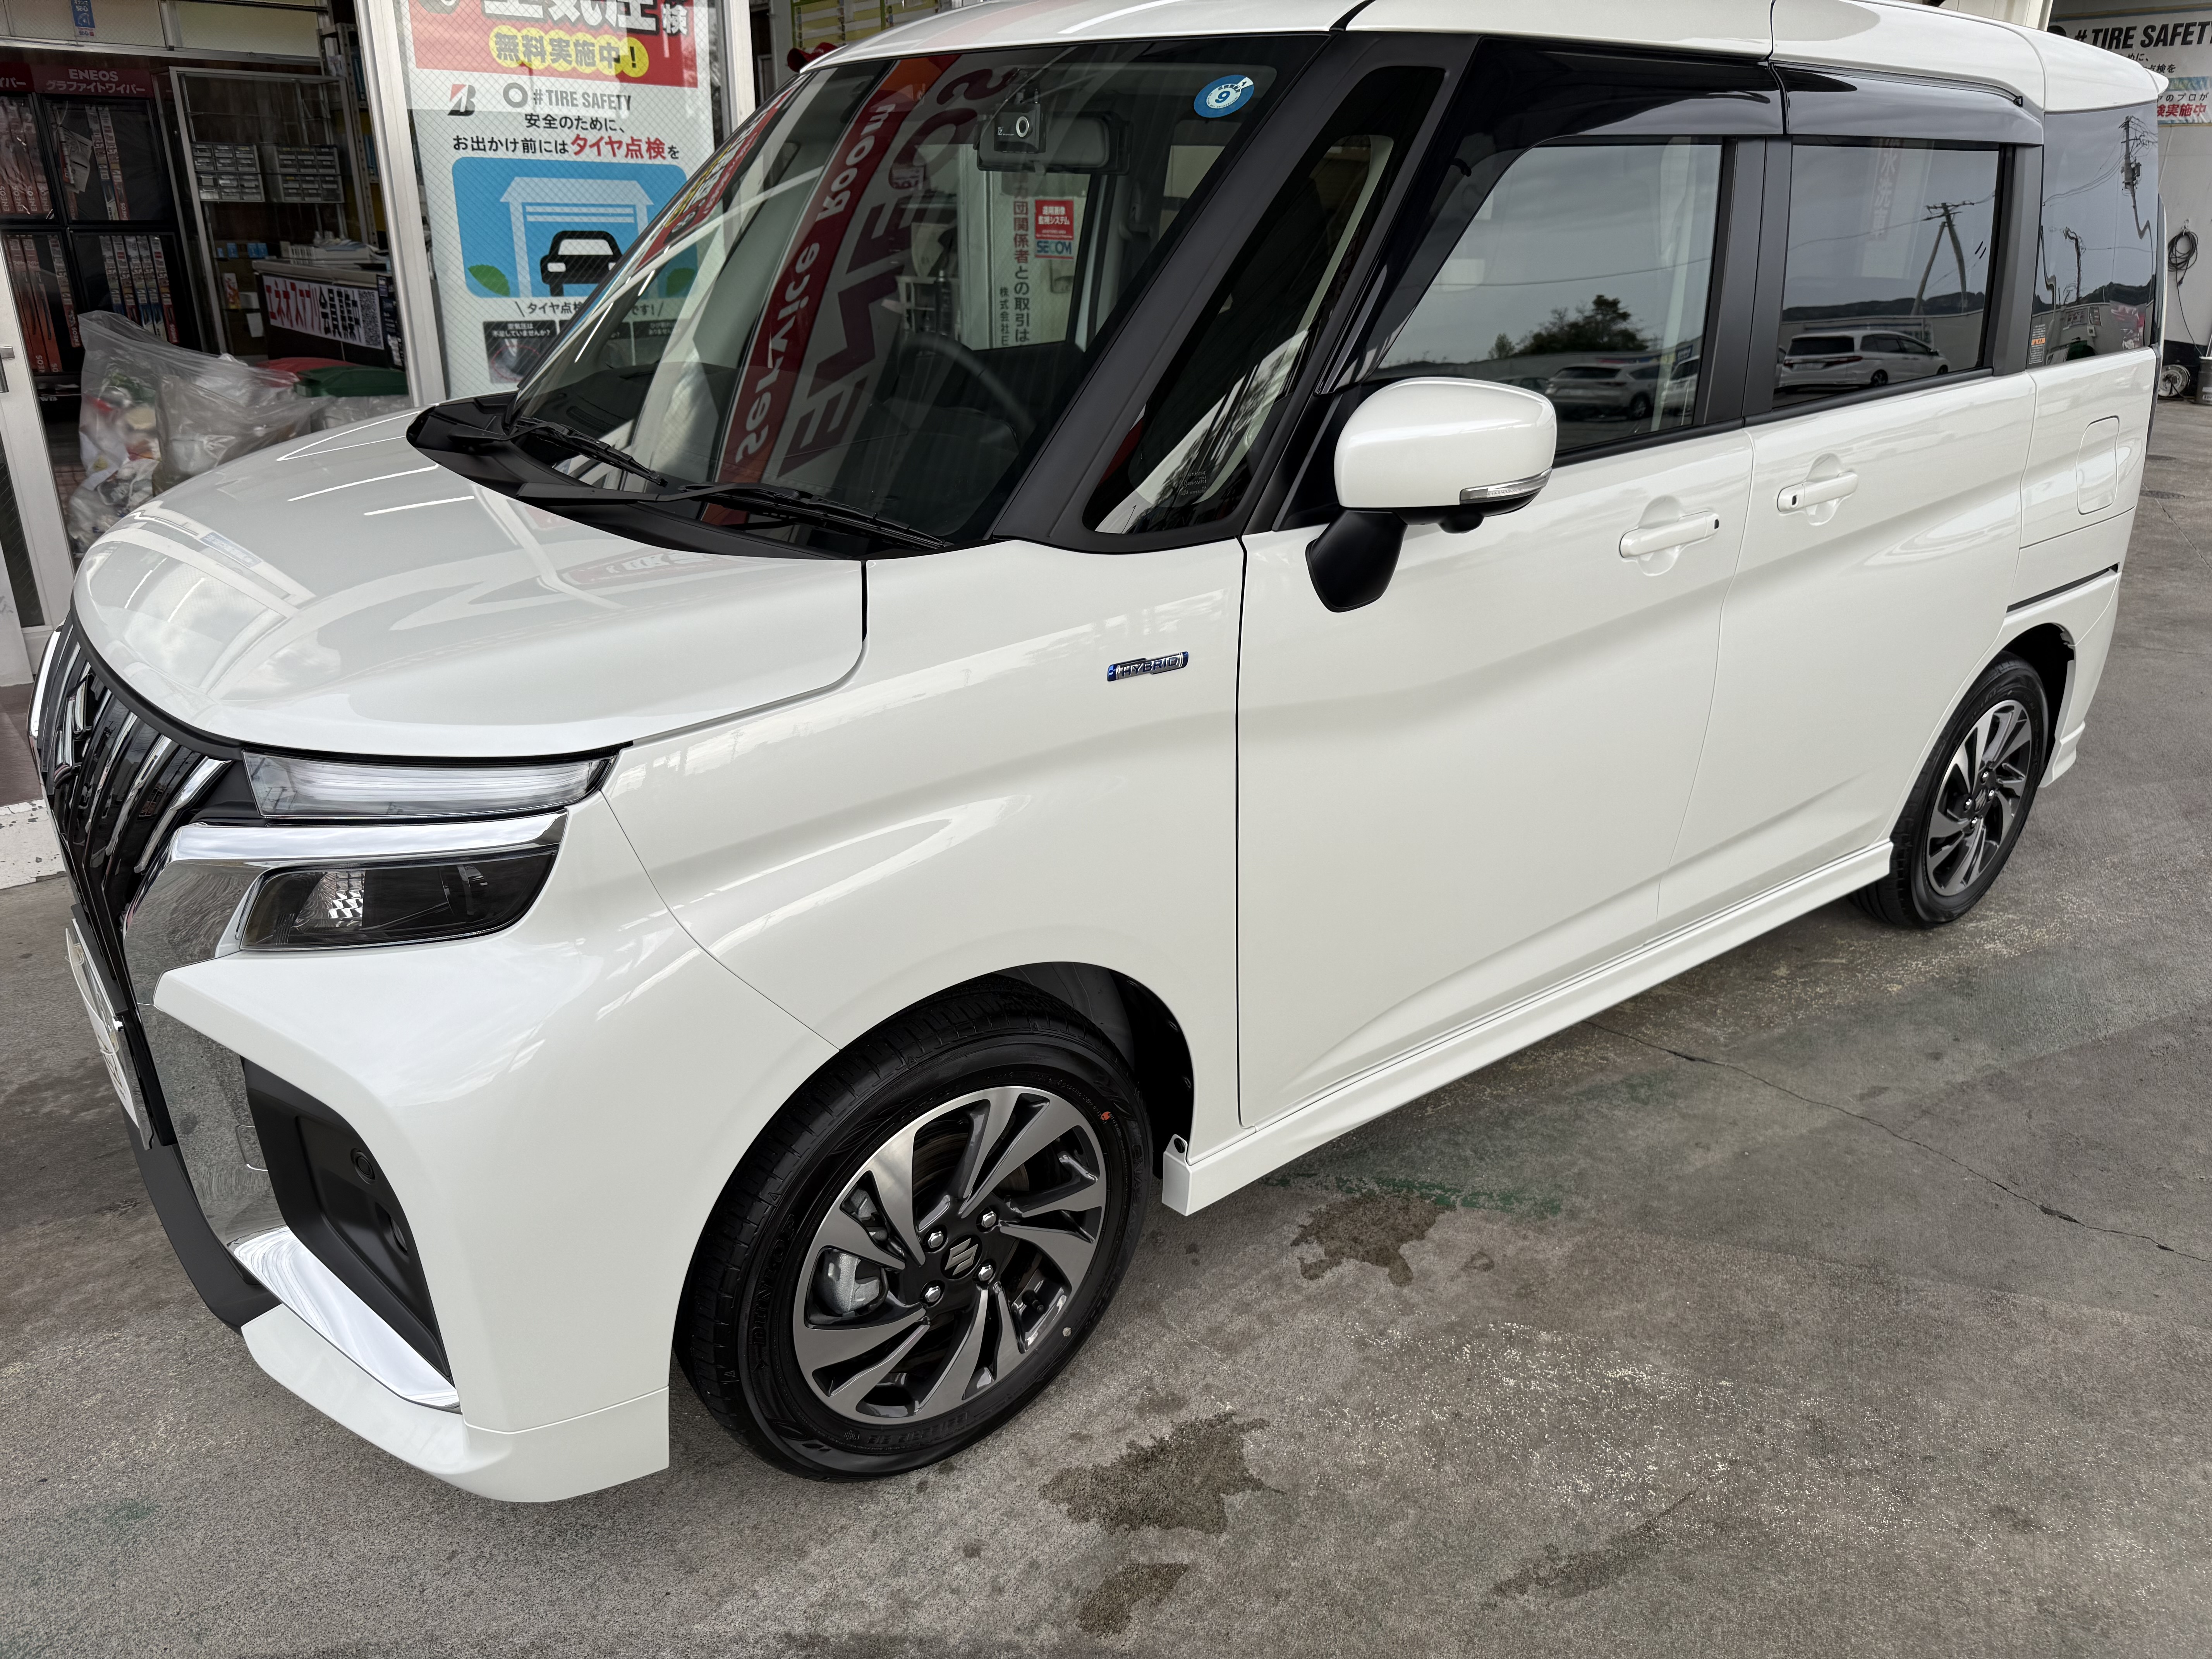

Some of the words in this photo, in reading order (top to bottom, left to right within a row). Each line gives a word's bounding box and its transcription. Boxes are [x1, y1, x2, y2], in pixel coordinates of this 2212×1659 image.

[2140, 21, 2212, 48] SAFET
[68, 69, 118, 82] ENEOS
[45, 80, 146, 94] グラファイトワイパー
[582, 92, 632, 111] SAFETY
[524, 113, 625, 133] 安全のために、
[453, 134, 680, 160] お出かけ前にはタイヤ点検を
[120, 202, 129, 220] NEOS
[1037, 240, 1071, 255] SECOM
[1121, 656, 1178, 676] HYBRID
